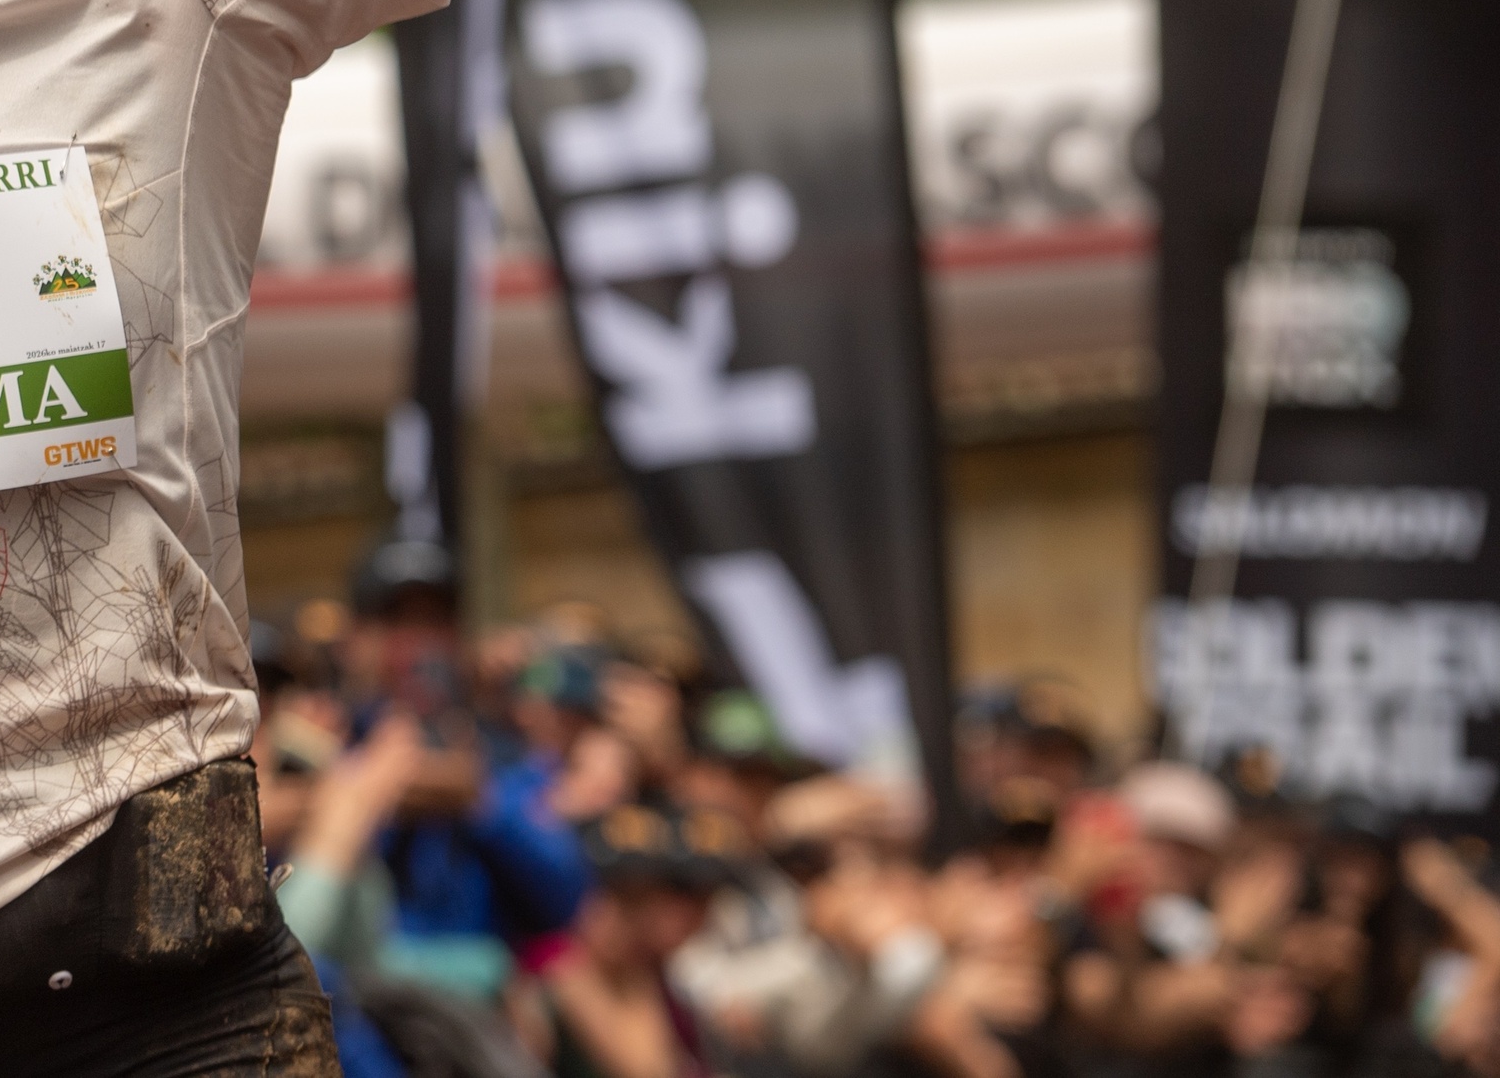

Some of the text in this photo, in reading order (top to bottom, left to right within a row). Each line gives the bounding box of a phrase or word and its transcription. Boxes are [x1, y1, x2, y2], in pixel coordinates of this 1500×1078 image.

[58, 341, 95, 354] maiatzak
[96, 340, 106, 349] 17
[43, 435, 117, 467] GTWS
